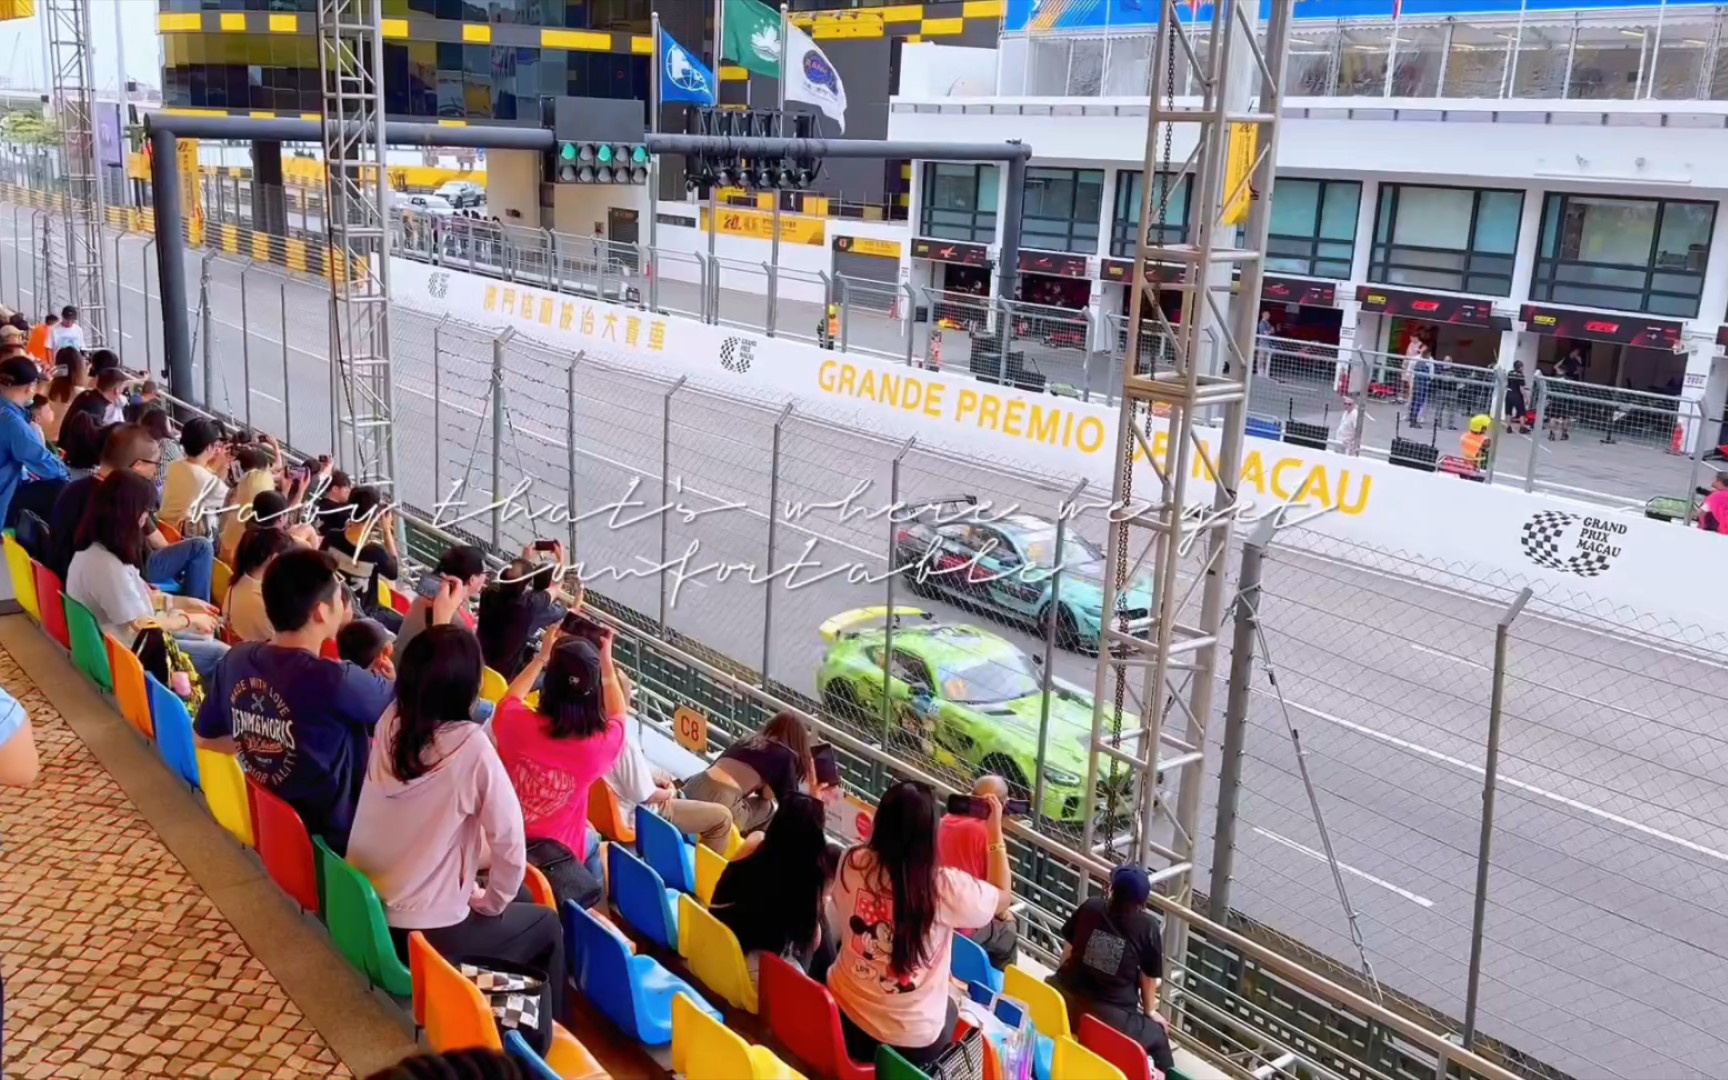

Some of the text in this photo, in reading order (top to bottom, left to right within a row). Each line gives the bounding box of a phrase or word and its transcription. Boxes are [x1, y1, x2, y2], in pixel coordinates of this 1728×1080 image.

[818, 360, 946, 418] GRANDE
[1580, 528, 1610, 544] PRIX
[1583, 517, 1628, 535] GRAND
[1576, 539, 1622, 558] MACAU
[269, 687, 290, 717] LOVE
[680, 714, 700, 742] C8
